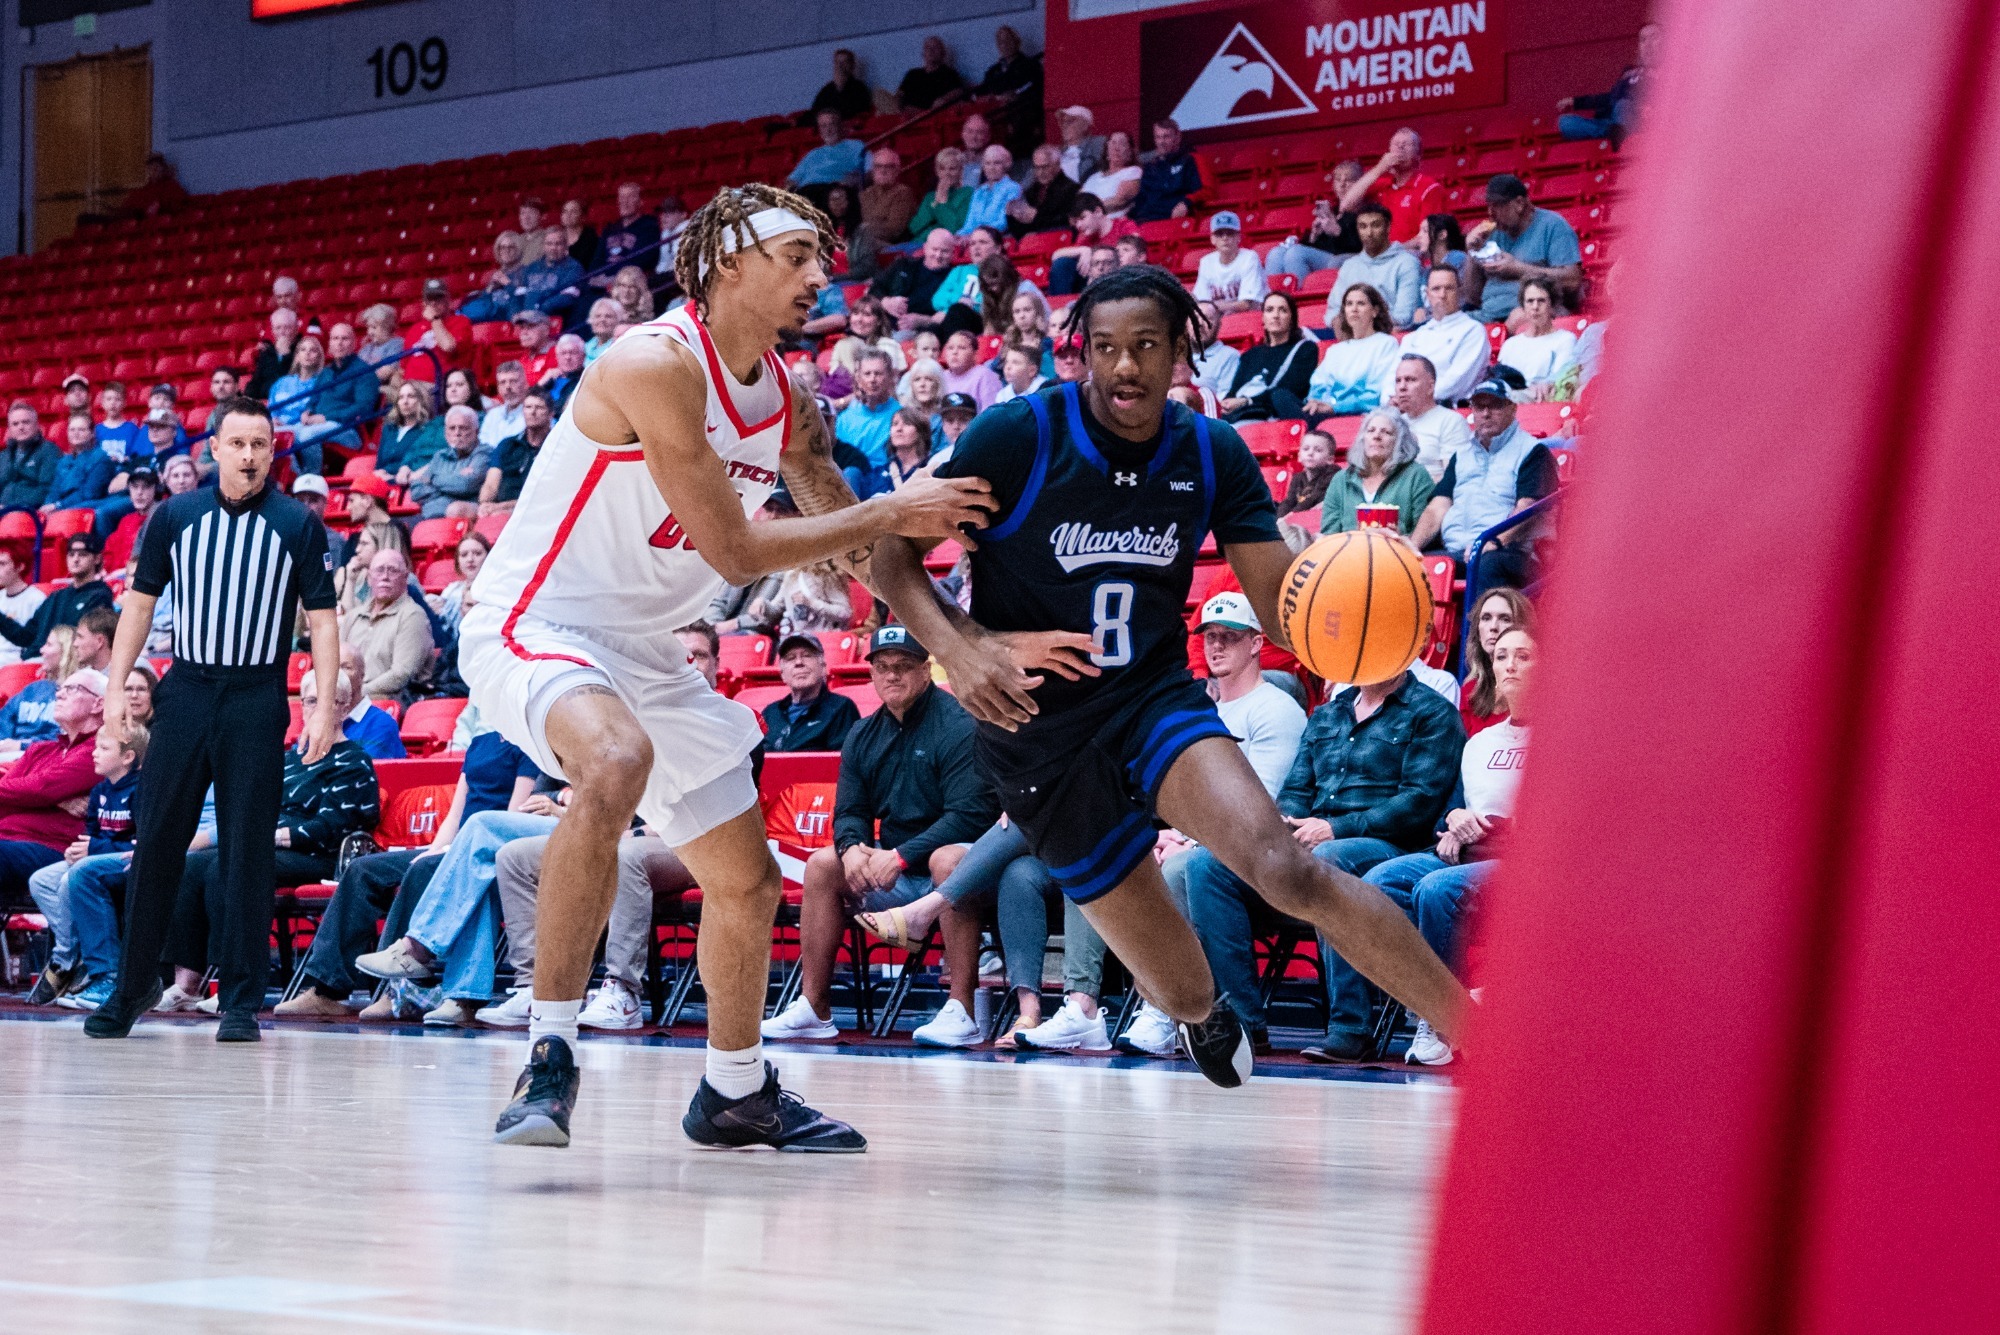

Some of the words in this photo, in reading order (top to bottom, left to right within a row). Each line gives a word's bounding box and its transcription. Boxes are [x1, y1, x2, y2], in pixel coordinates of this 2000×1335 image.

[1306, 0, 1486, 58] MOUNTAIN
[367, 36, 448, 98] 109
[1314, 41, 1474, 93] AMERICA
[1331, 89, 1396, 110] CREDIT
[1400, 81, 1455, 101] UNION
[1169, 481, 1194, 491] WAC
[1050, 522, 1180, 558] Mavericks
[1090, 582, 1135, 668] 8
